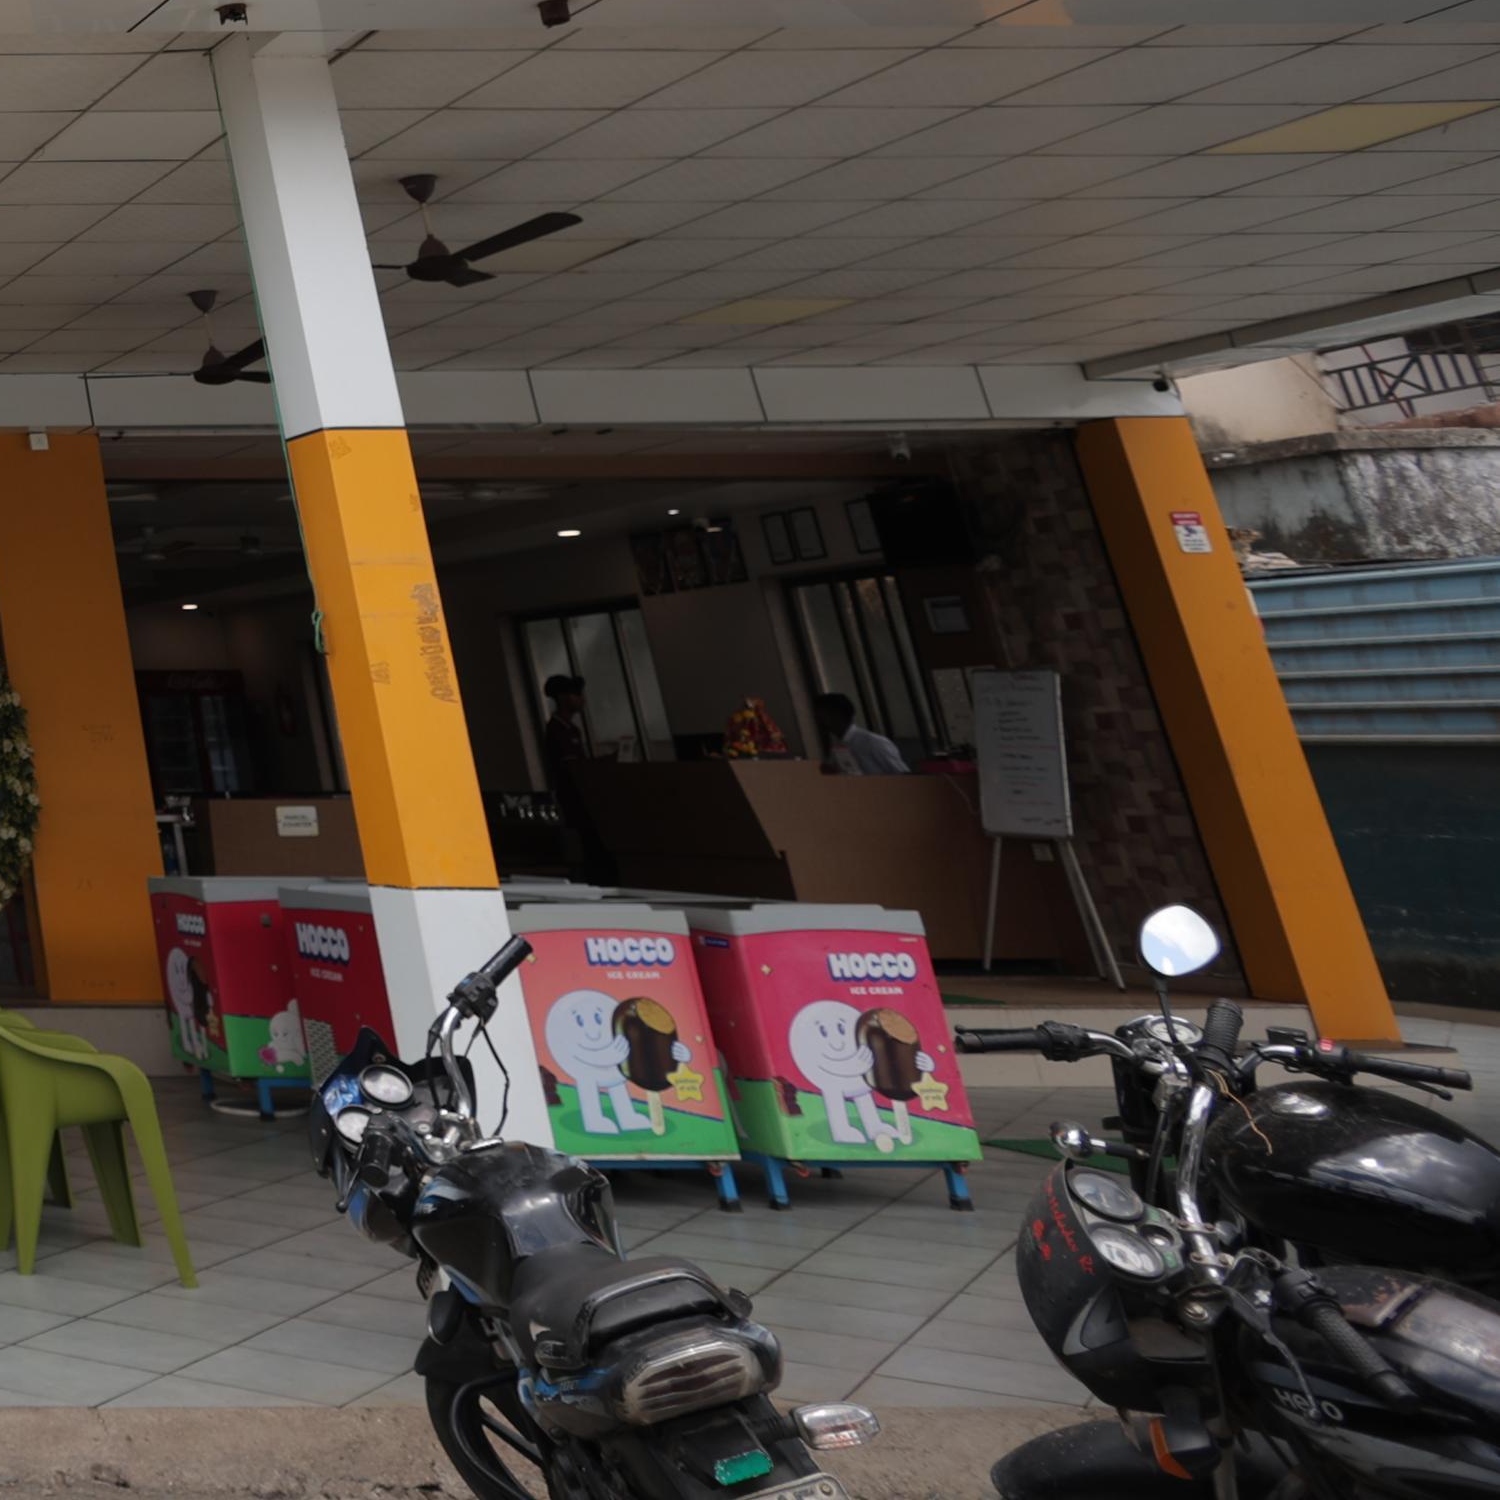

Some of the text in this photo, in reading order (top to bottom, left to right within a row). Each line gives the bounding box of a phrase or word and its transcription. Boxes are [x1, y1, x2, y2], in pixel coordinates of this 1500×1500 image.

[294, 922, 350, 966] HOCCO
[584, 937, 675, 967] HOCCO
[607, 970, 661, 980] ICE CREAM
[827, 952, 918, 982] HOCCO
[850, 986, 904, 996] ICE CREAM
[1272, 1386, 1345, 1422] Heo
